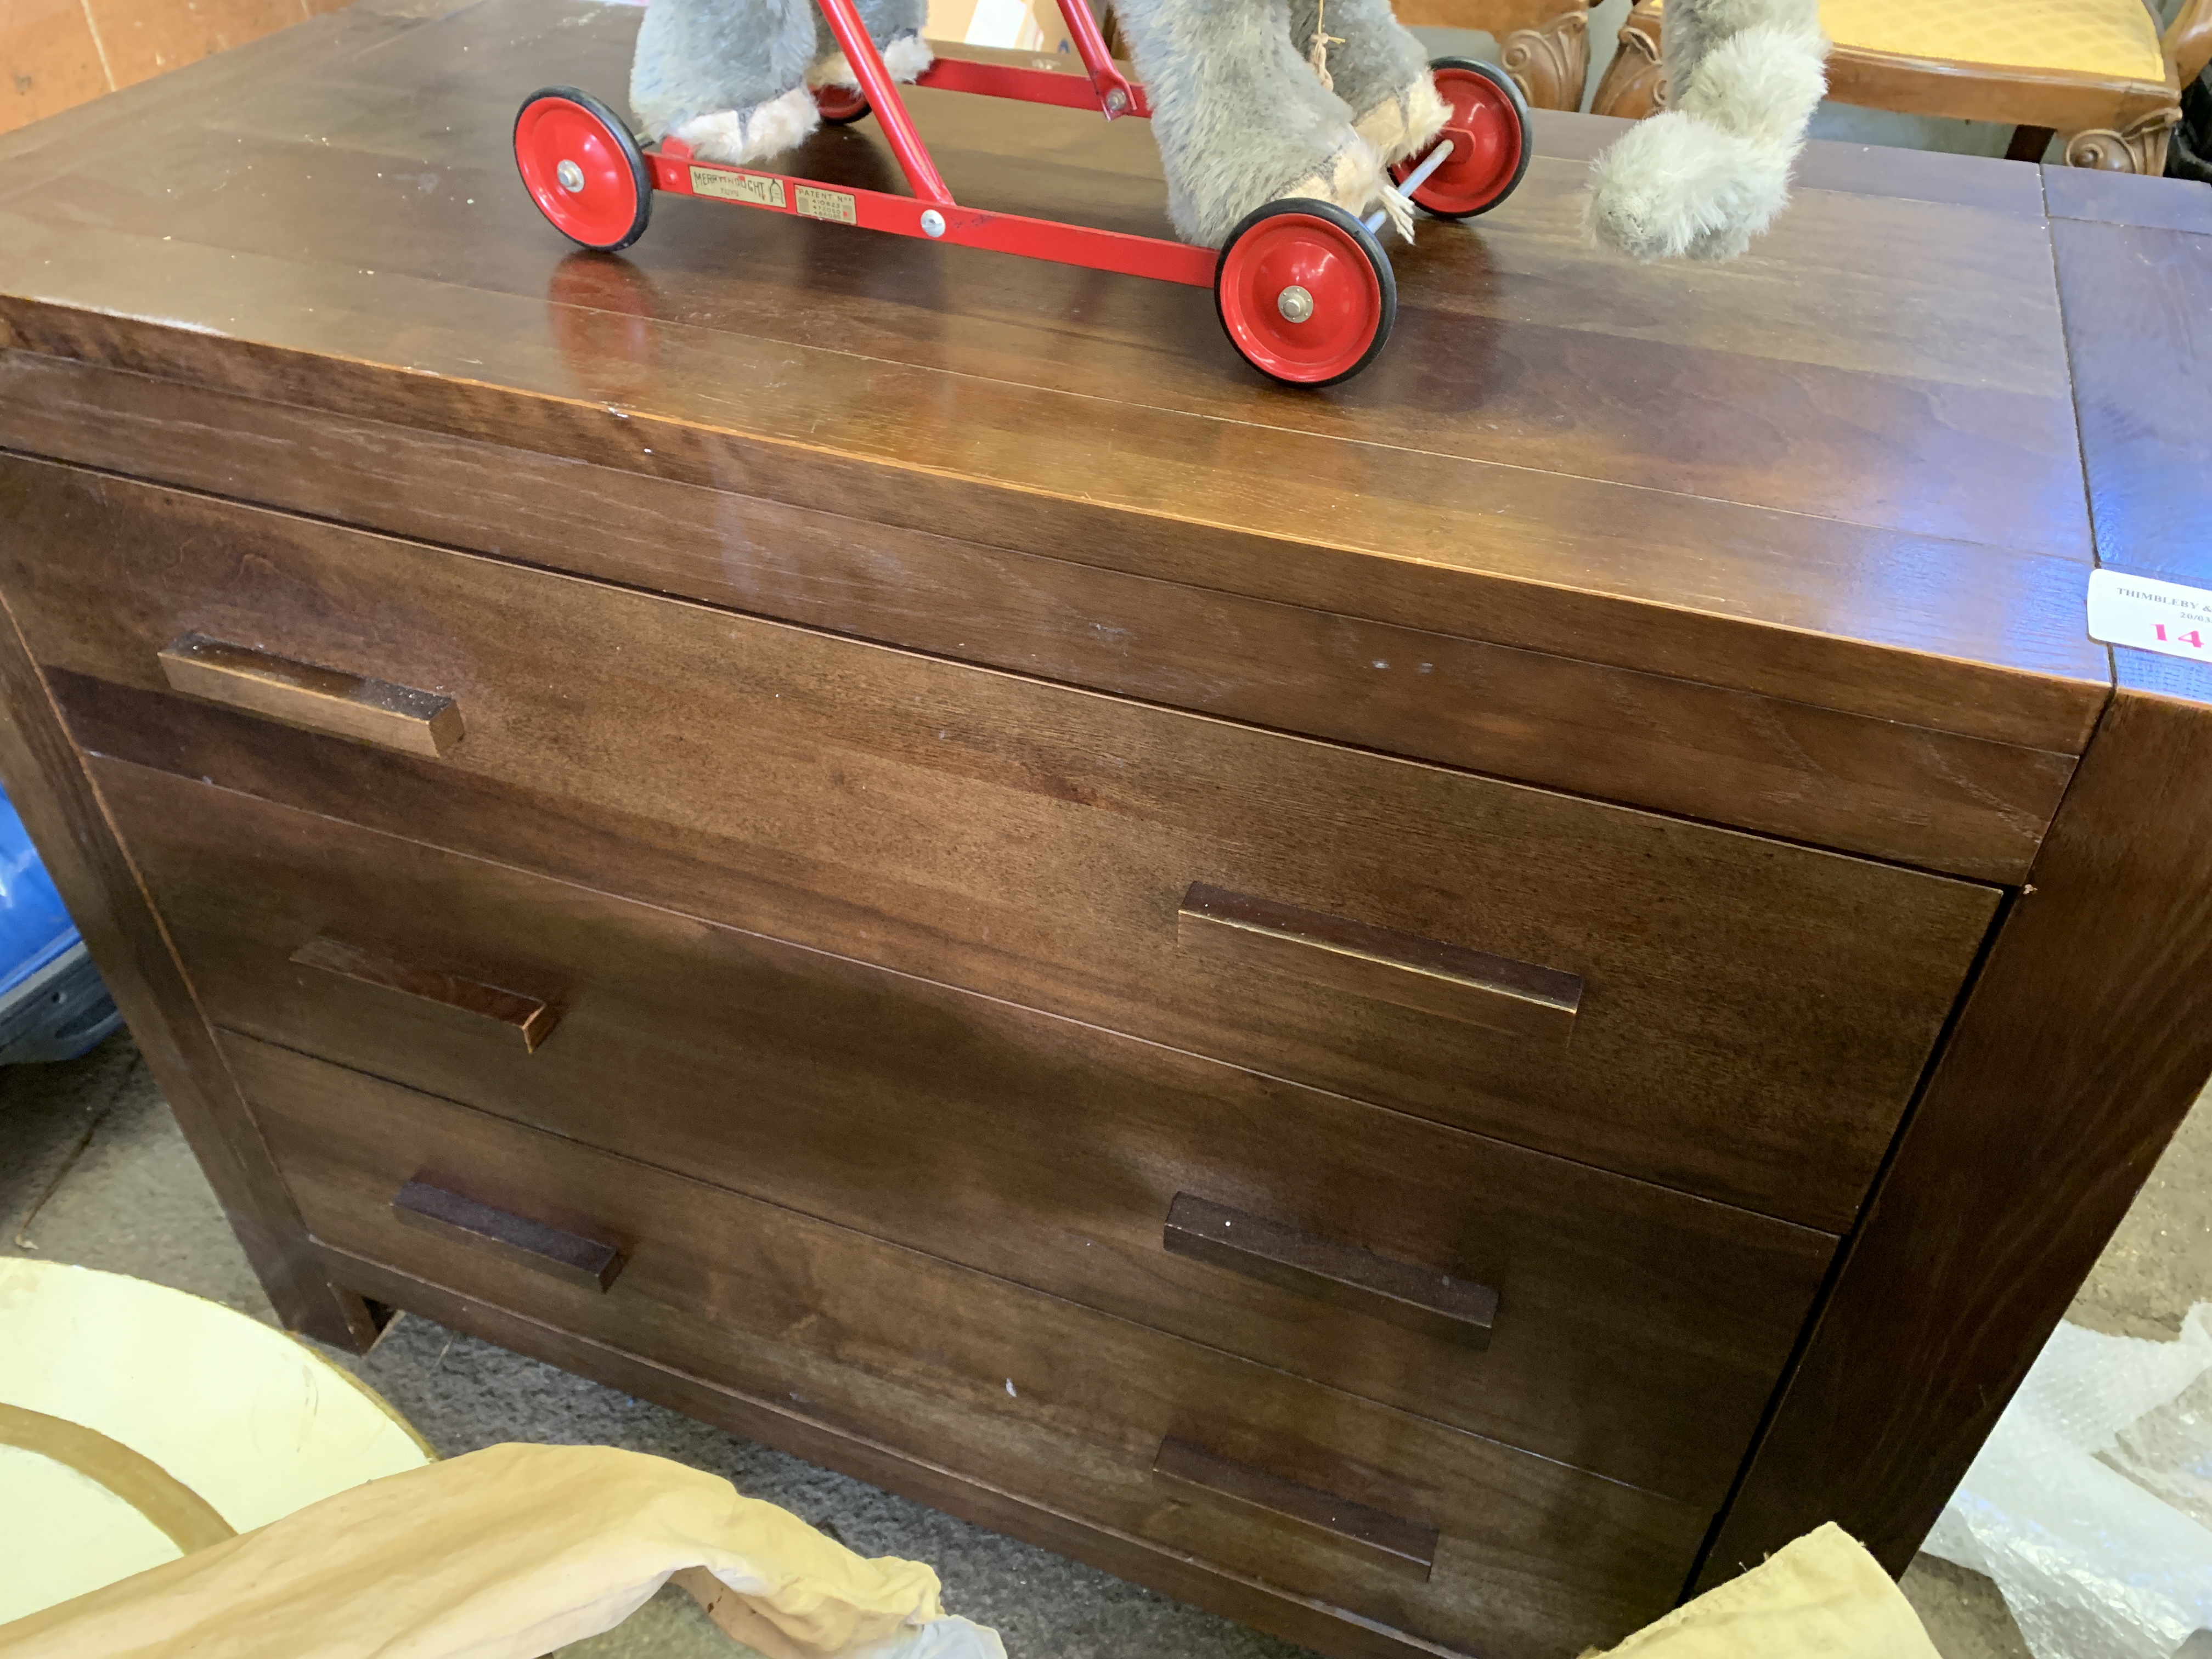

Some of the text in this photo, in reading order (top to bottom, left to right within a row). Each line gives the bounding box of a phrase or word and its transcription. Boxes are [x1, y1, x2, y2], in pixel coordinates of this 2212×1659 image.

[694, 172, 764, 200] MERRYTHOUGHT
[799, 189, 832, 200] PATENT
[2118, 588, 2199, 609] THIMBLEBY
